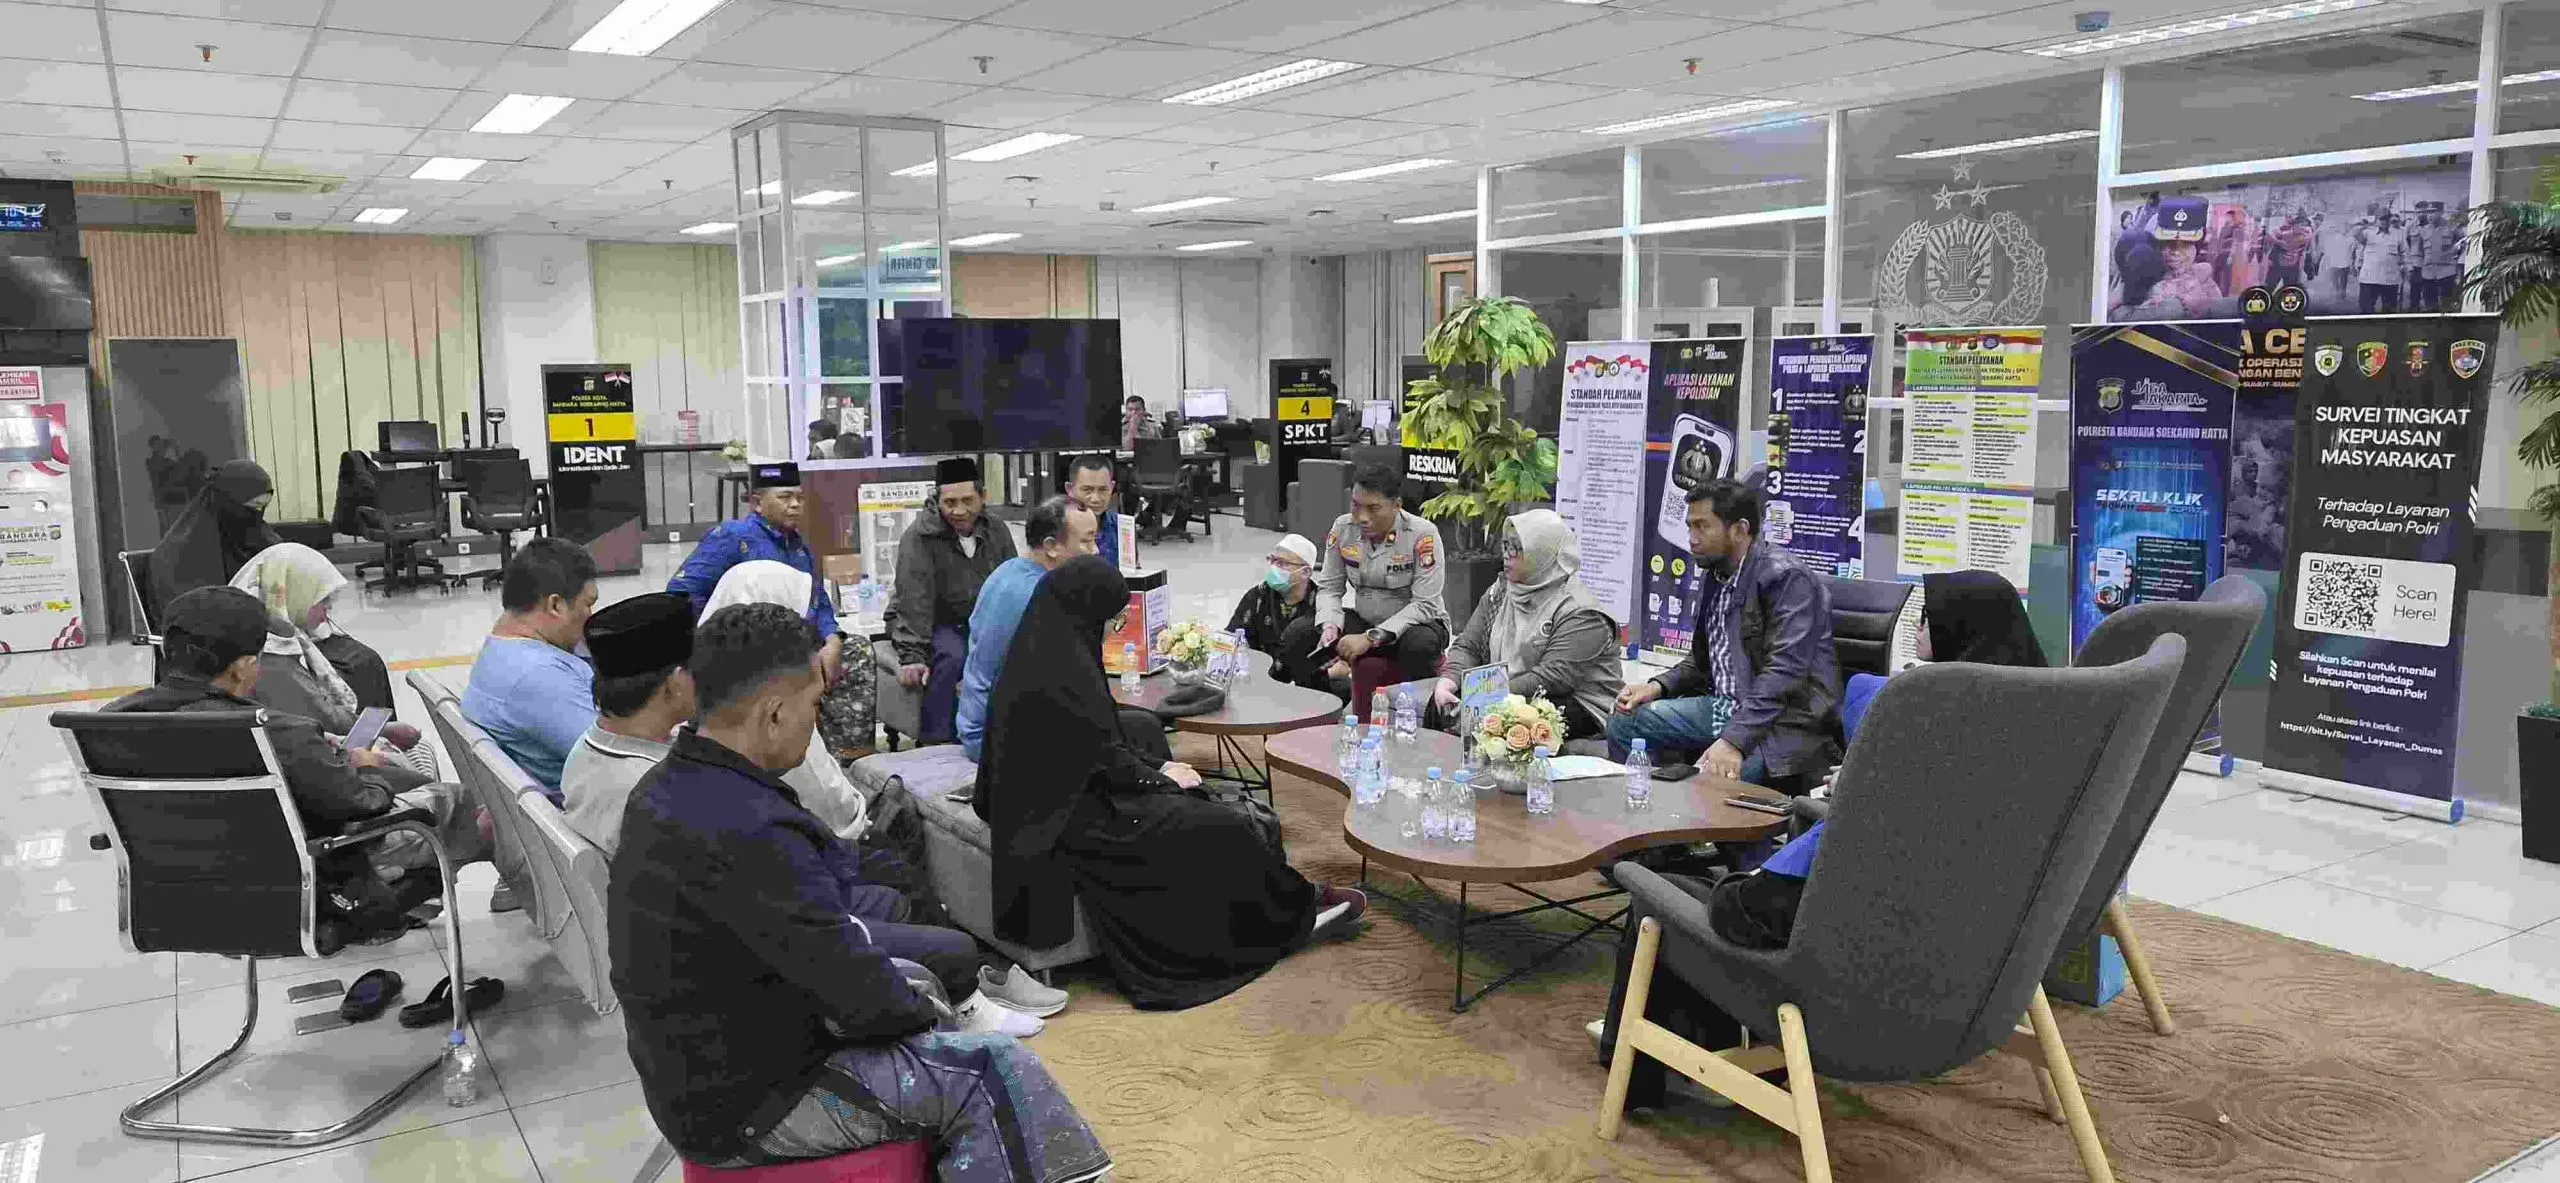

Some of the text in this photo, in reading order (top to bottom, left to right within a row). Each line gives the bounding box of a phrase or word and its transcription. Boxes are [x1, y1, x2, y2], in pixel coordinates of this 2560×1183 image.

[2265, 328, 2306, 354] CE
[1939, 355, 2004, 365] STANDAR PELAYANAN
[2246, 358, 2304, 367] OPERASI
[1664, 373, 1735, 386] APLIKASI LAYANAN
[2274, 369, 2302, 378] BEN
[1570, 389, 1642, 400] STANDAR PELAYANAN
[1676, 386, 1721, 400] KEPOLISIAN
[1772, 387, 1783, 411] 1
[1301, 400, 1310, 416] 4
[2315, 406, 2471, 425] SURVEI TINGKAT
[585, 418, 594, 437] 1
[1284, 423, 1328, 439] SPKT
[2077, 425, 2228, 440] POLRESTA BANDARA SOEKARNO HATTA
[1853, 430, 1866, 454] 2
[2337, 428, 2442, 447] KEPUASAN
[563, 446, 626, 464] IDENT
[1409, 454, 1457, 475] RESKRIM
[2321, 449, 2456, 470] MASYARAKAT
[1767, 471, 1781, 494] 3
[2096, 488, 2204, 506] SEKALI KLIK
[2317, 497, 2450, 518] Terhadap Layanan
[1848, 516, 1864, 542] 4
[2322, 515, 2439, 535] Pengaduan Polri
[2396, 584, 2437, 602] Scan
[2393, 604, 2437, 622] Here!
[2299, 651, 2437, 677] Silahkan Scan untuk menilai
[2316, 665, 2414, 687] kepuasan terhadap
[2303, 674, 2427, 700] Layanan Pengaduan Polri
[2317, 713, 2336, 723] Atau
[2336, 716, 2358, 726] akses
[2359, 718, 2372, 728] link
